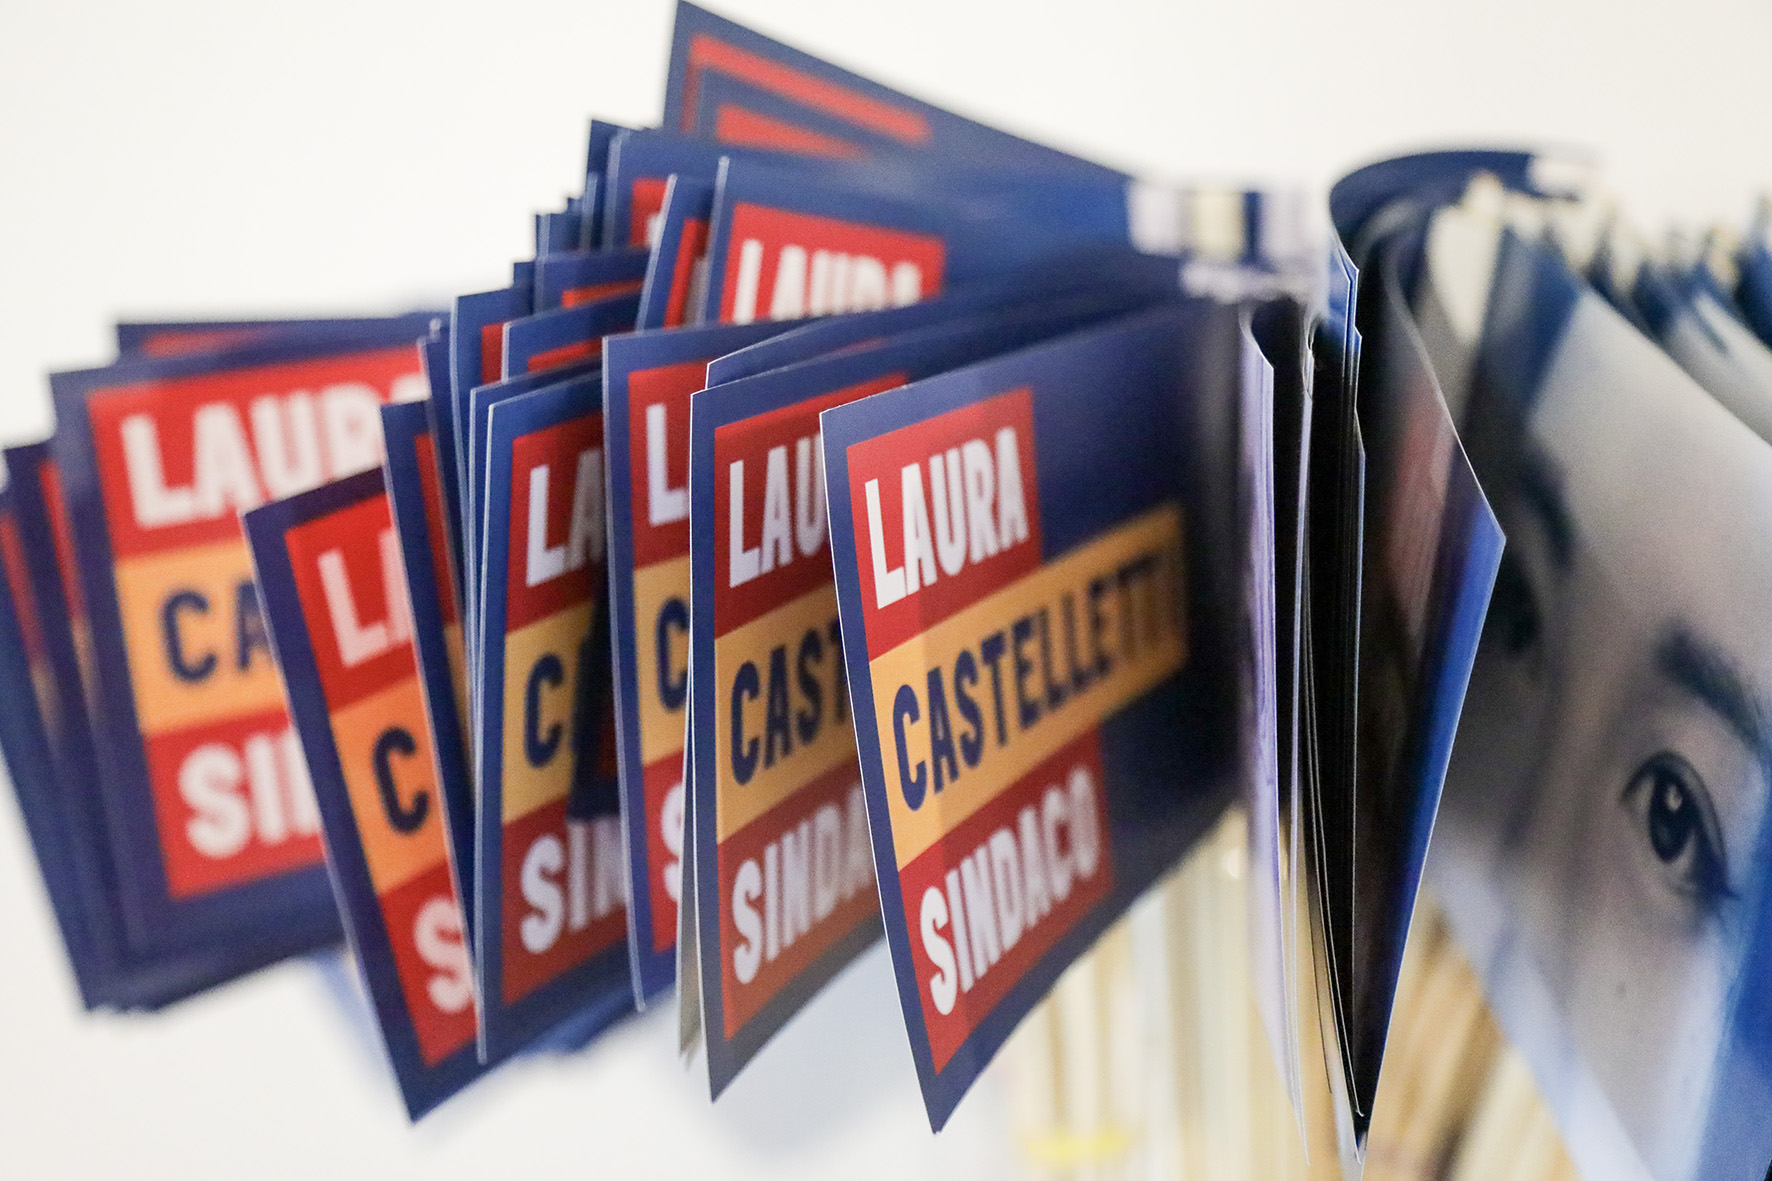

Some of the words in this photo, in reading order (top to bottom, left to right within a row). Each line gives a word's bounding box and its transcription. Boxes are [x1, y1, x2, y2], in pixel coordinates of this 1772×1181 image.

[120, 373, 431, 528] LAUR
[864, 427, 1029, 611] LAURA
[920, 764, 1099, 1016] SINDACO
